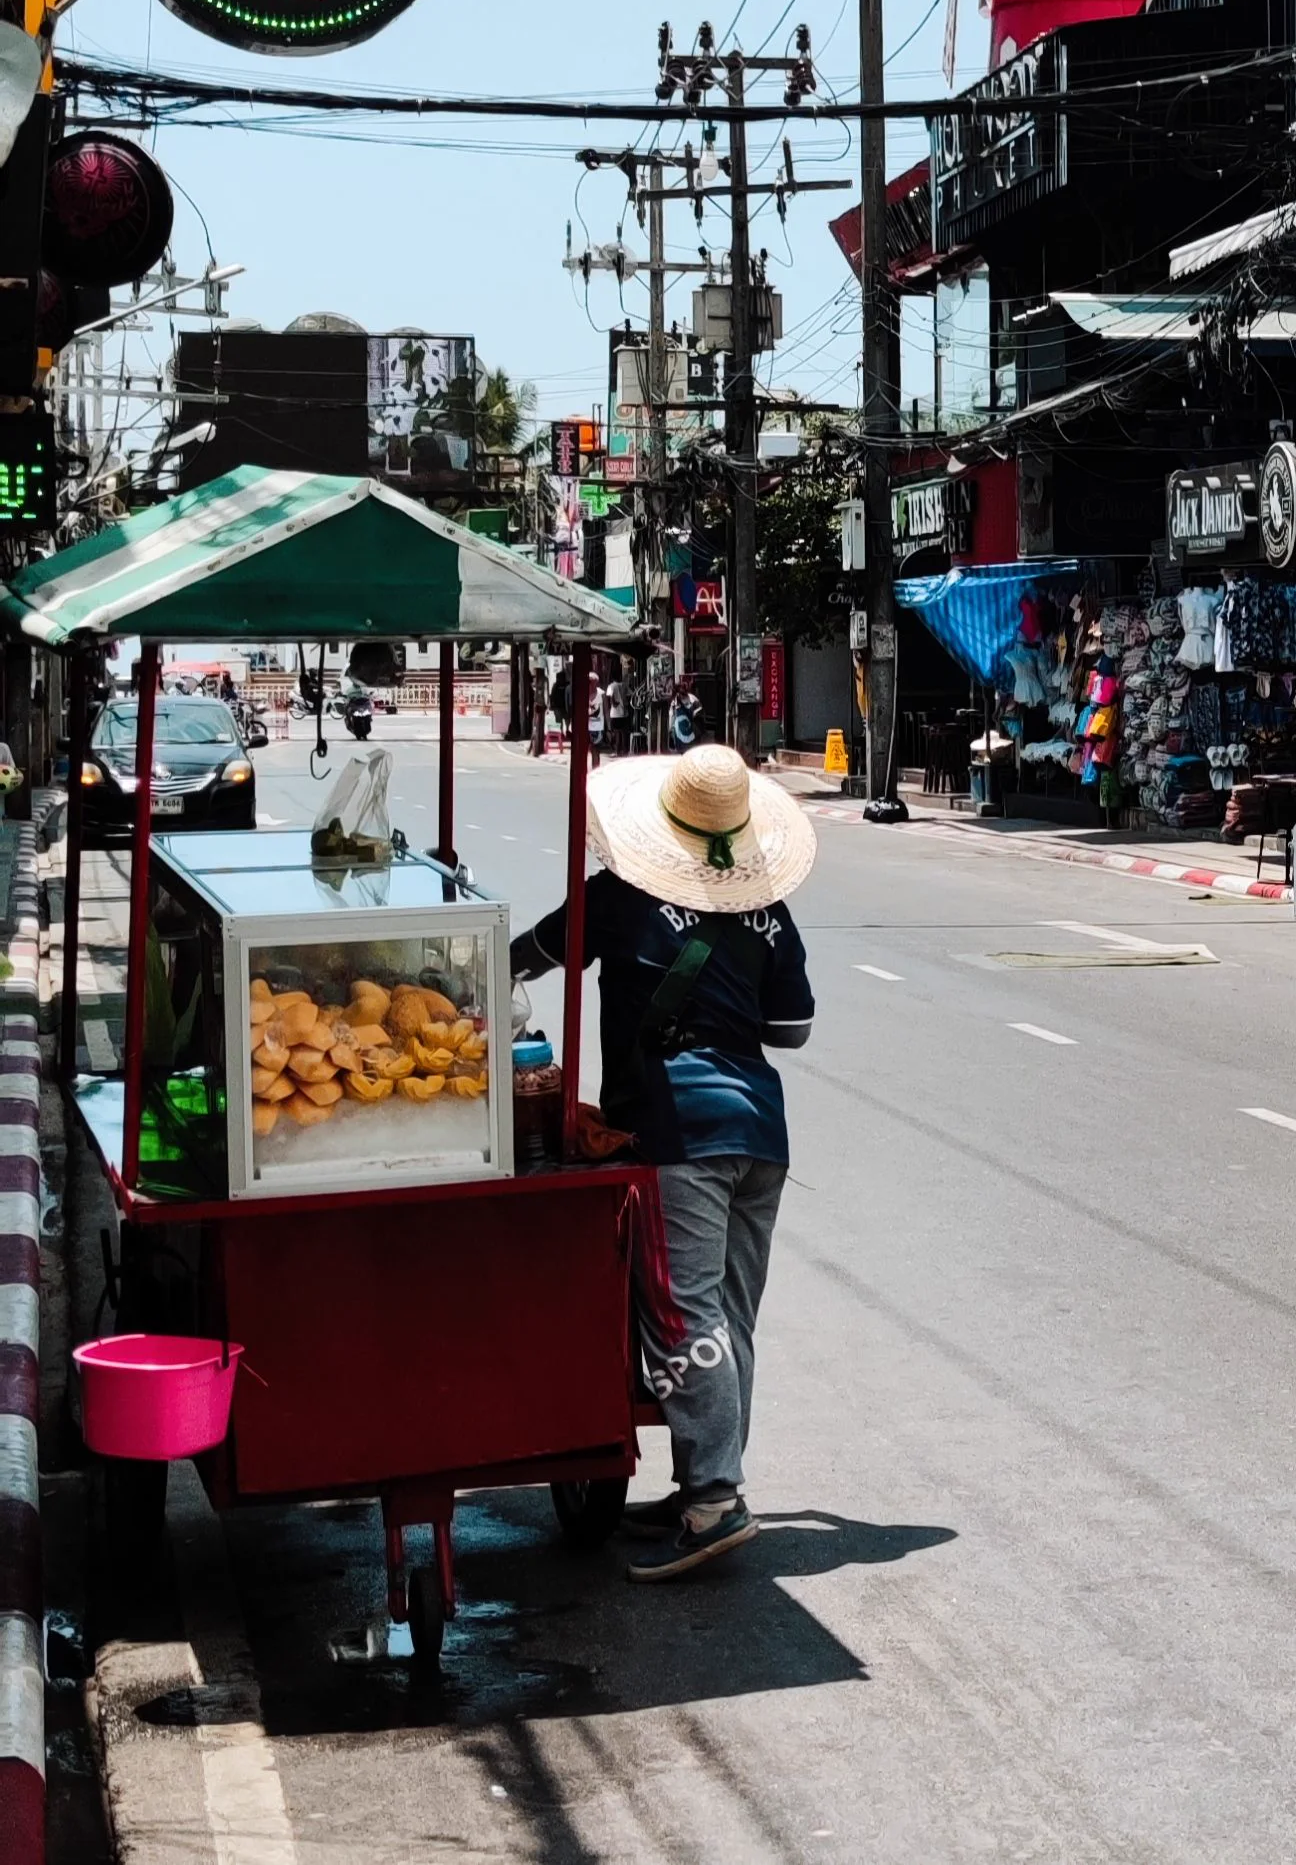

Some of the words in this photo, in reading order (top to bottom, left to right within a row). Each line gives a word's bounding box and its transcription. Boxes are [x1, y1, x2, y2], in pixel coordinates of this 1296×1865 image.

[908, 485, 945, 536] IRISH
[1171, 487, 1199, 537] JACK
[770, 651, 780, 718] EXCHANGE
